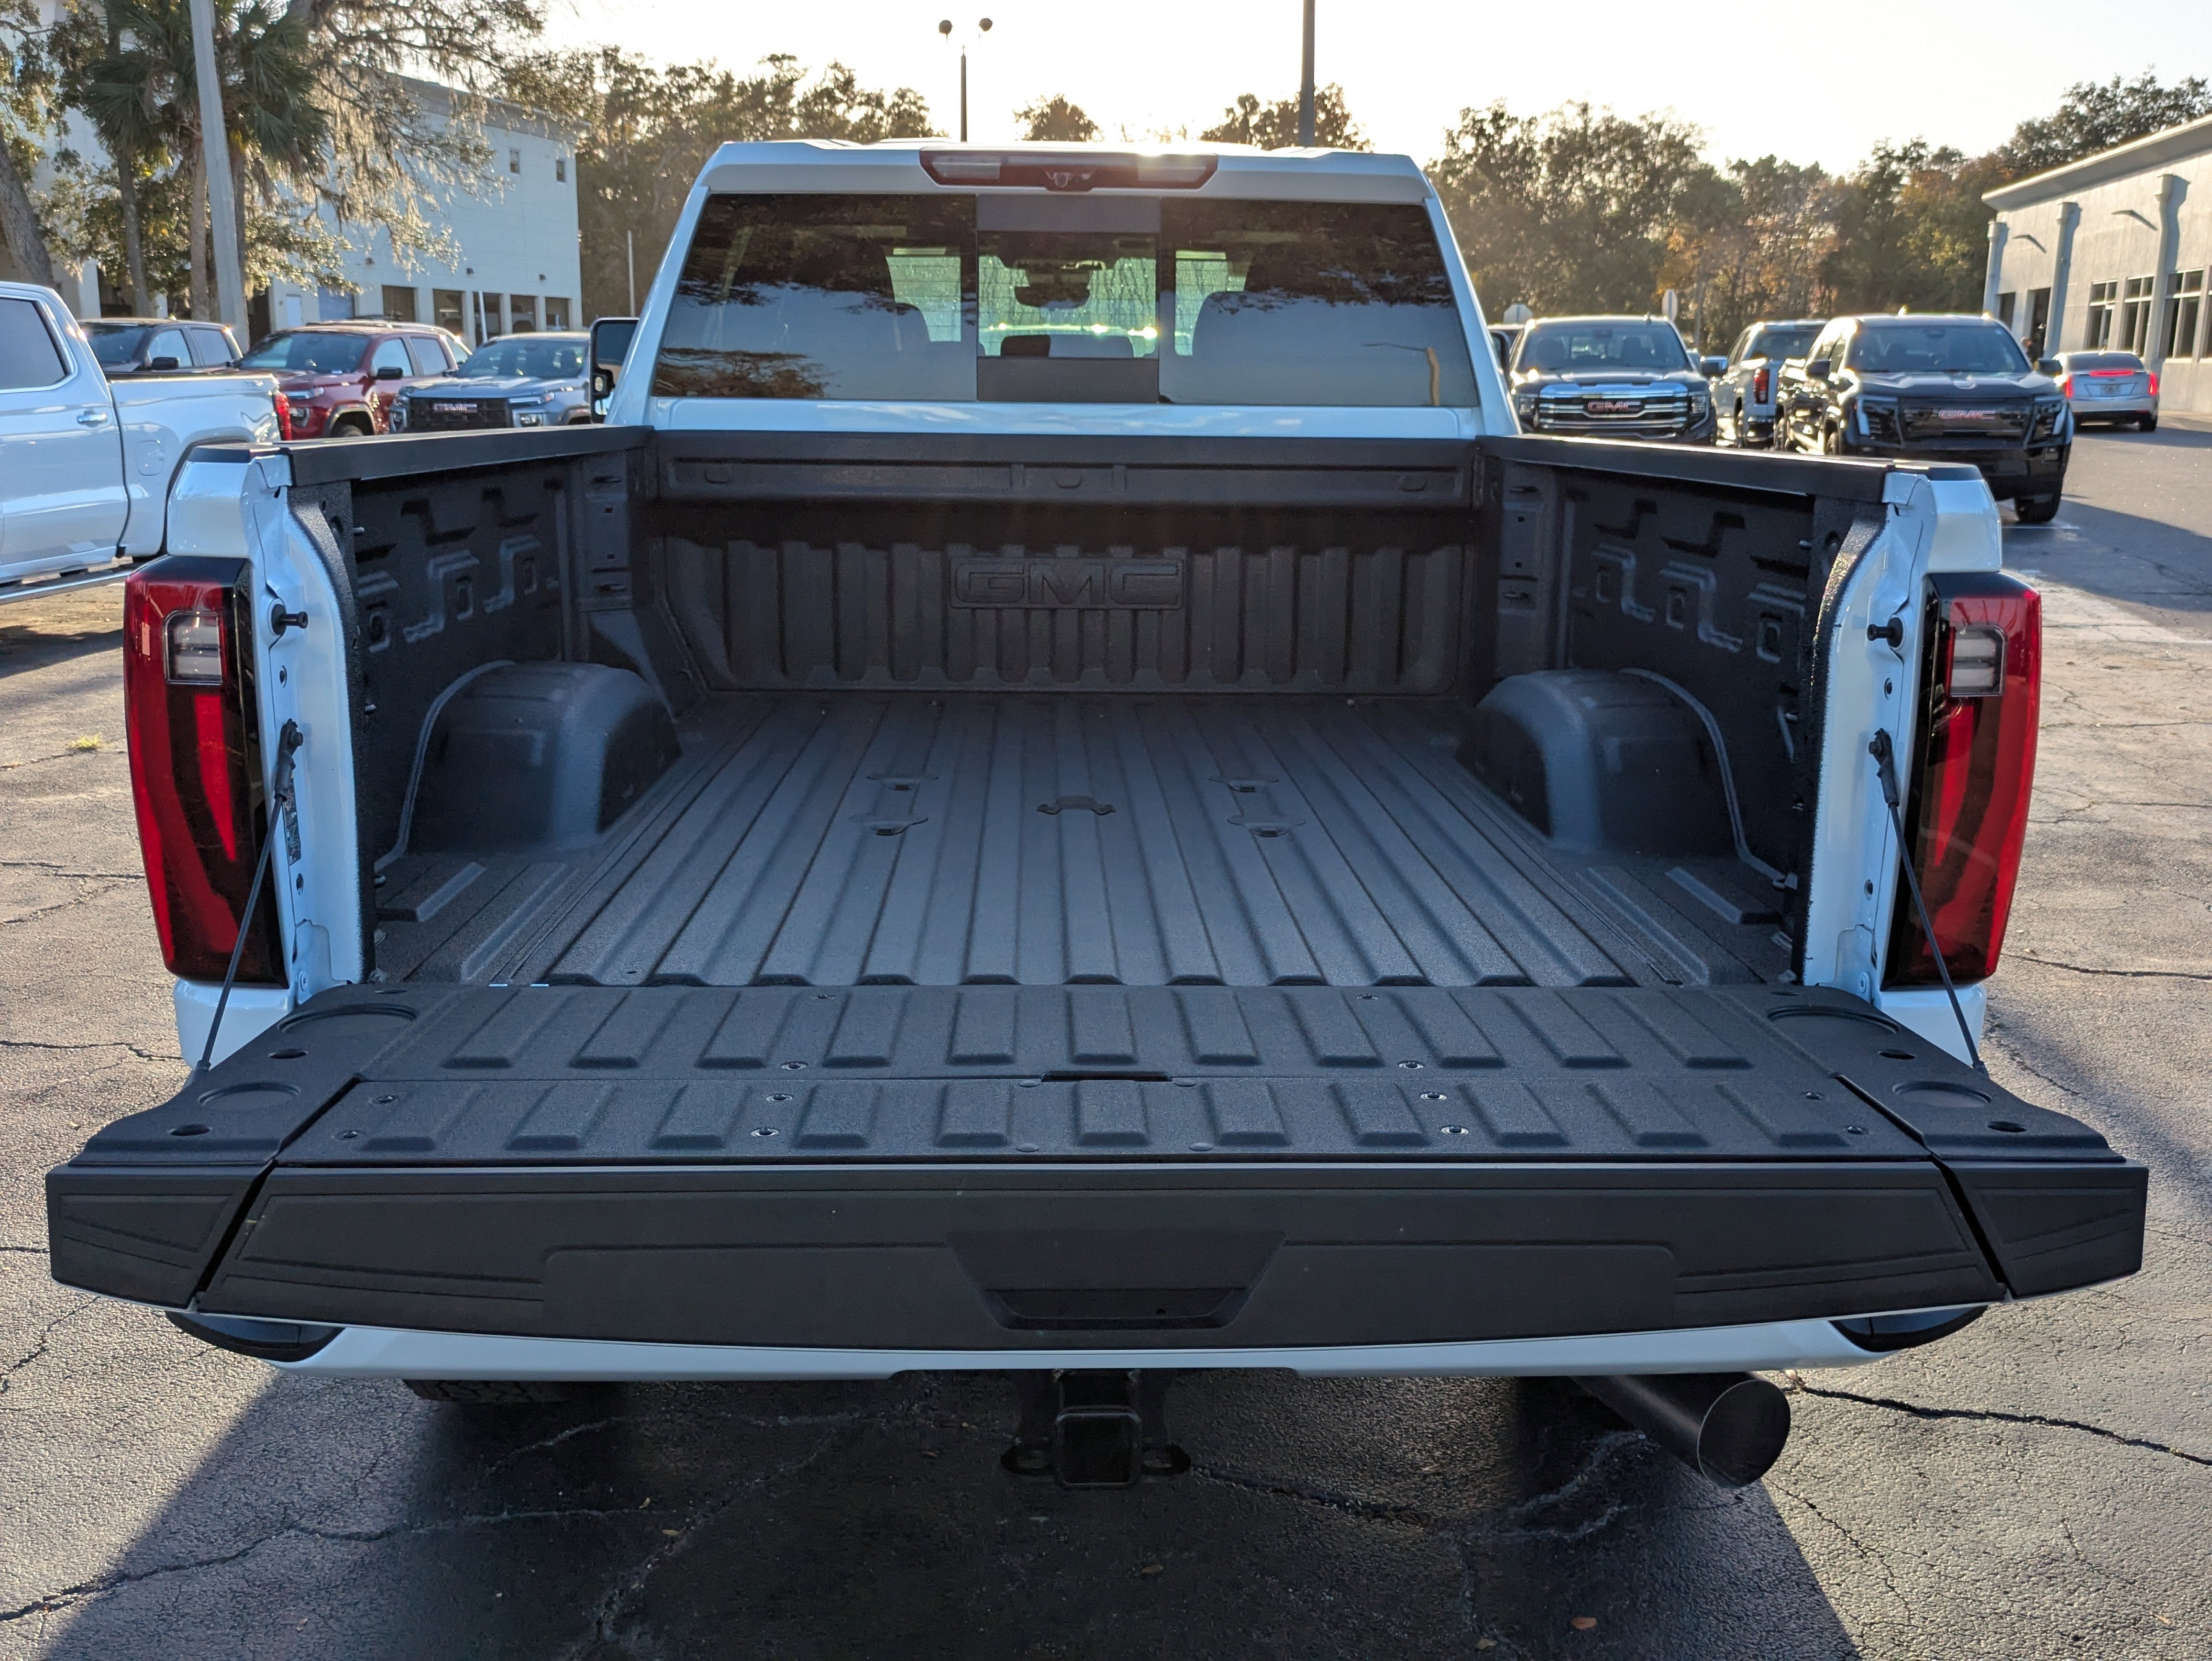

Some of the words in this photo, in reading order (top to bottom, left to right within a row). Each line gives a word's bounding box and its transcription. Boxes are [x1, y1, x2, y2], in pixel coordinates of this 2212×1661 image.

[1588, 401, 1640, 412] GMC
[1939, 410, 1996, 419] GMC
[956, 564, 1178, 605] GMC
